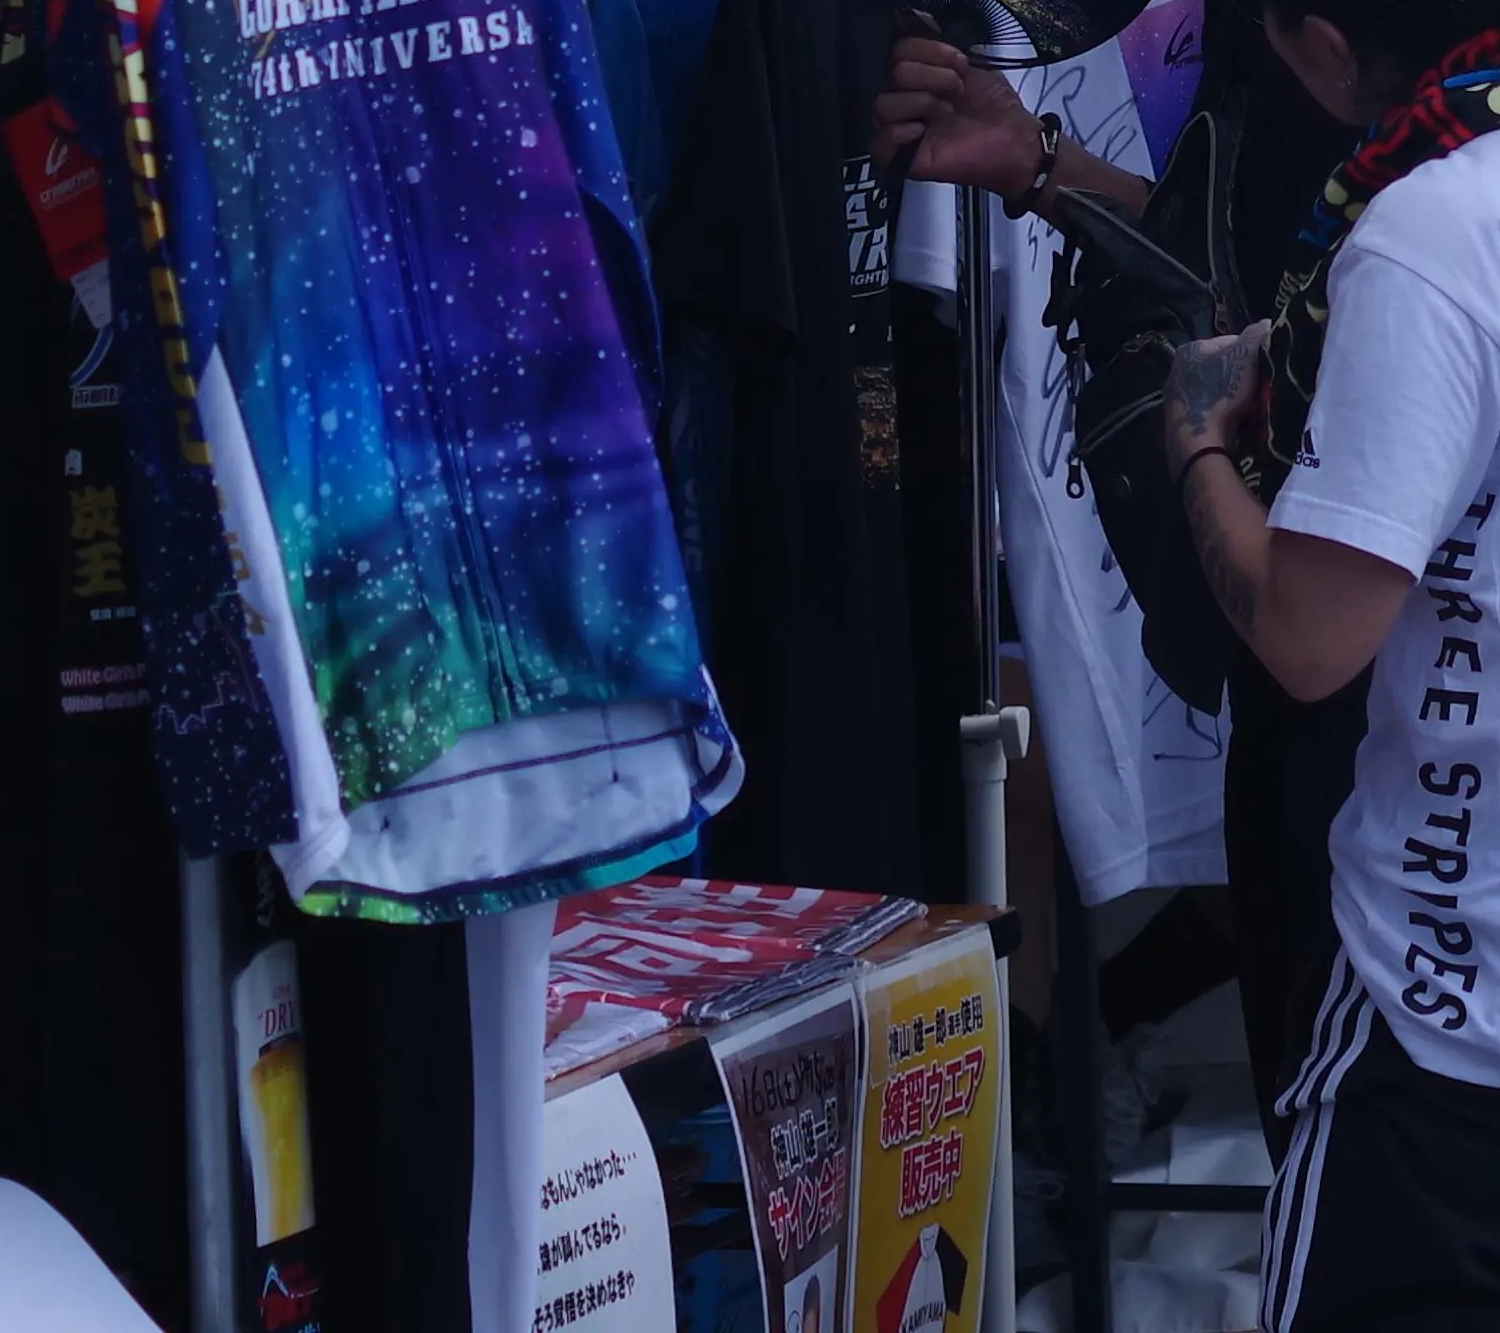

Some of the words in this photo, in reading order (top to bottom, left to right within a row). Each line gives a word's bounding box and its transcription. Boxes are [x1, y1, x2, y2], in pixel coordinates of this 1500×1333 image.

[1416, 492, 1497, 728] THREE
[1401, 761, 1484, 1032] STRIPES
[880, 1045, 986, 1150] 練習ウエア
[896, 1126, 965, 1219] 販売中
